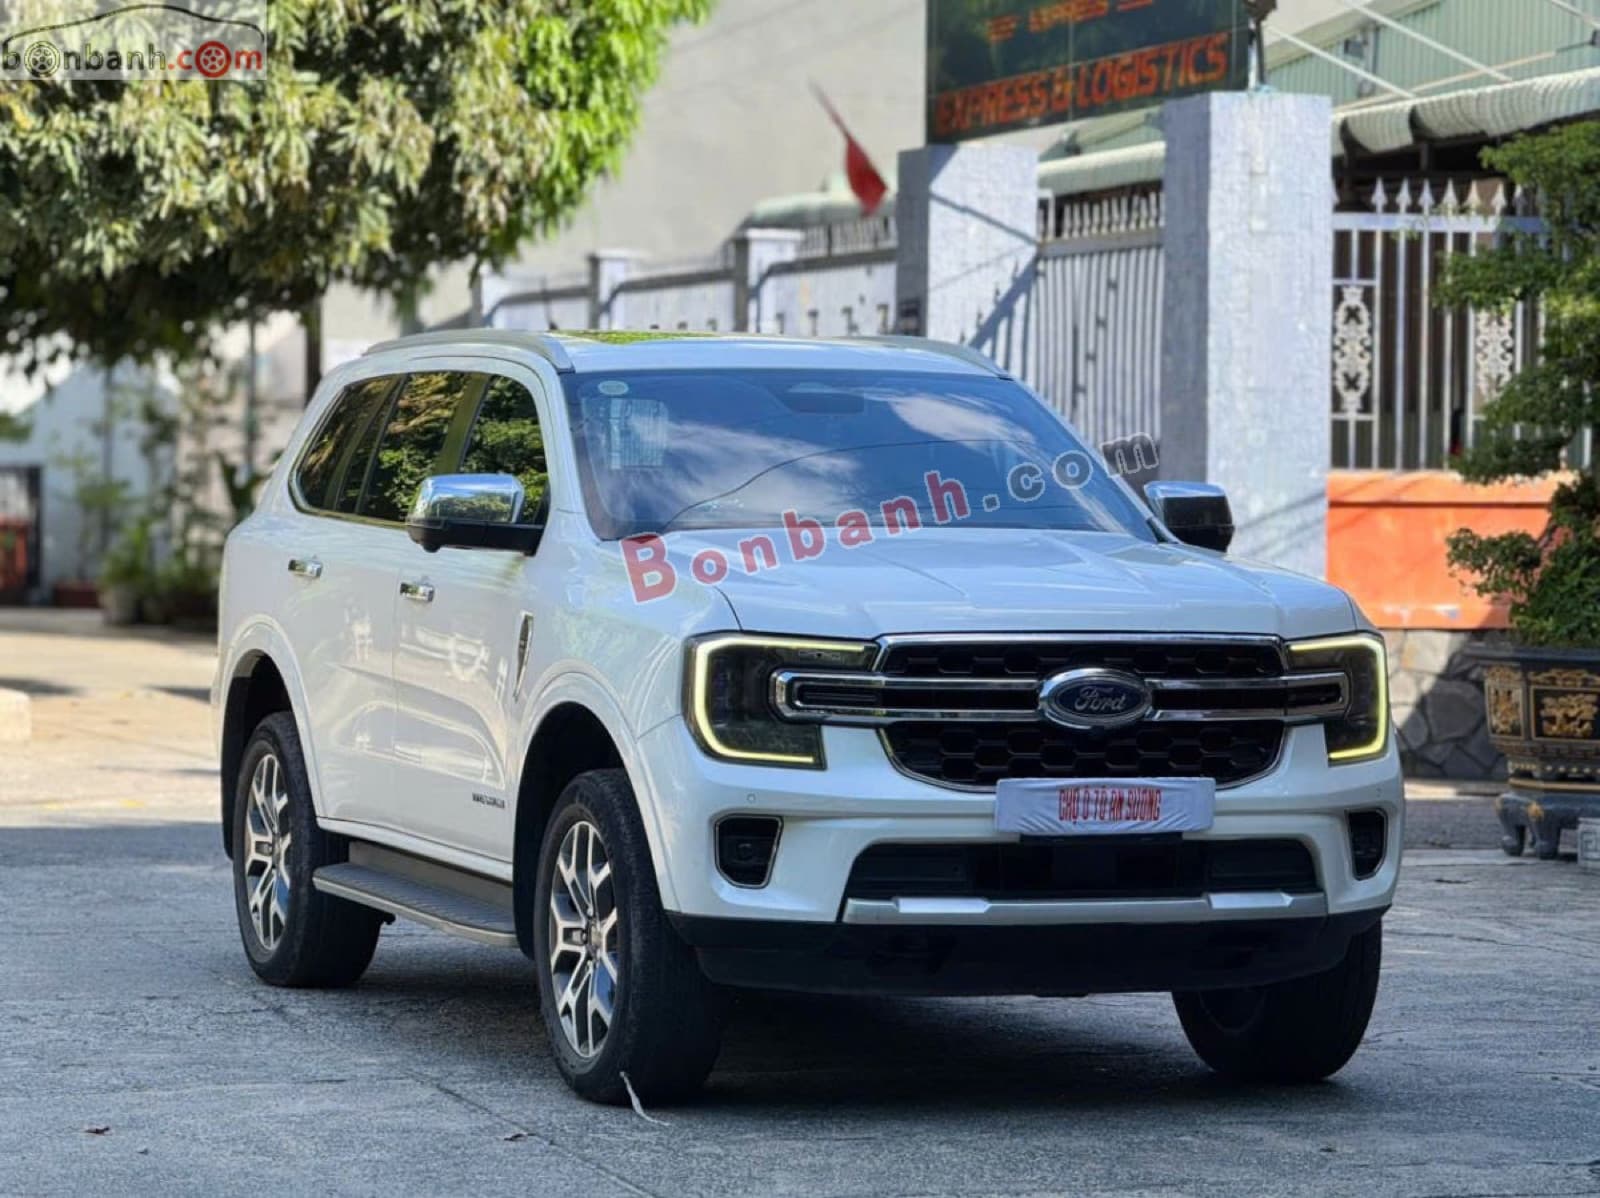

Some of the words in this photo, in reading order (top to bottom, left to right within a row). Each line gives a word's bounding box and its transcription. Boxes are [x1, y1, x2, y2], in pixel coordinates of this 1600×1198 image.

[936, 73, 1049, 134] EXPRESS
[1078, 34, 1229, 107] LOGISTICS
[1074, 686, 1126, 711] Ford
